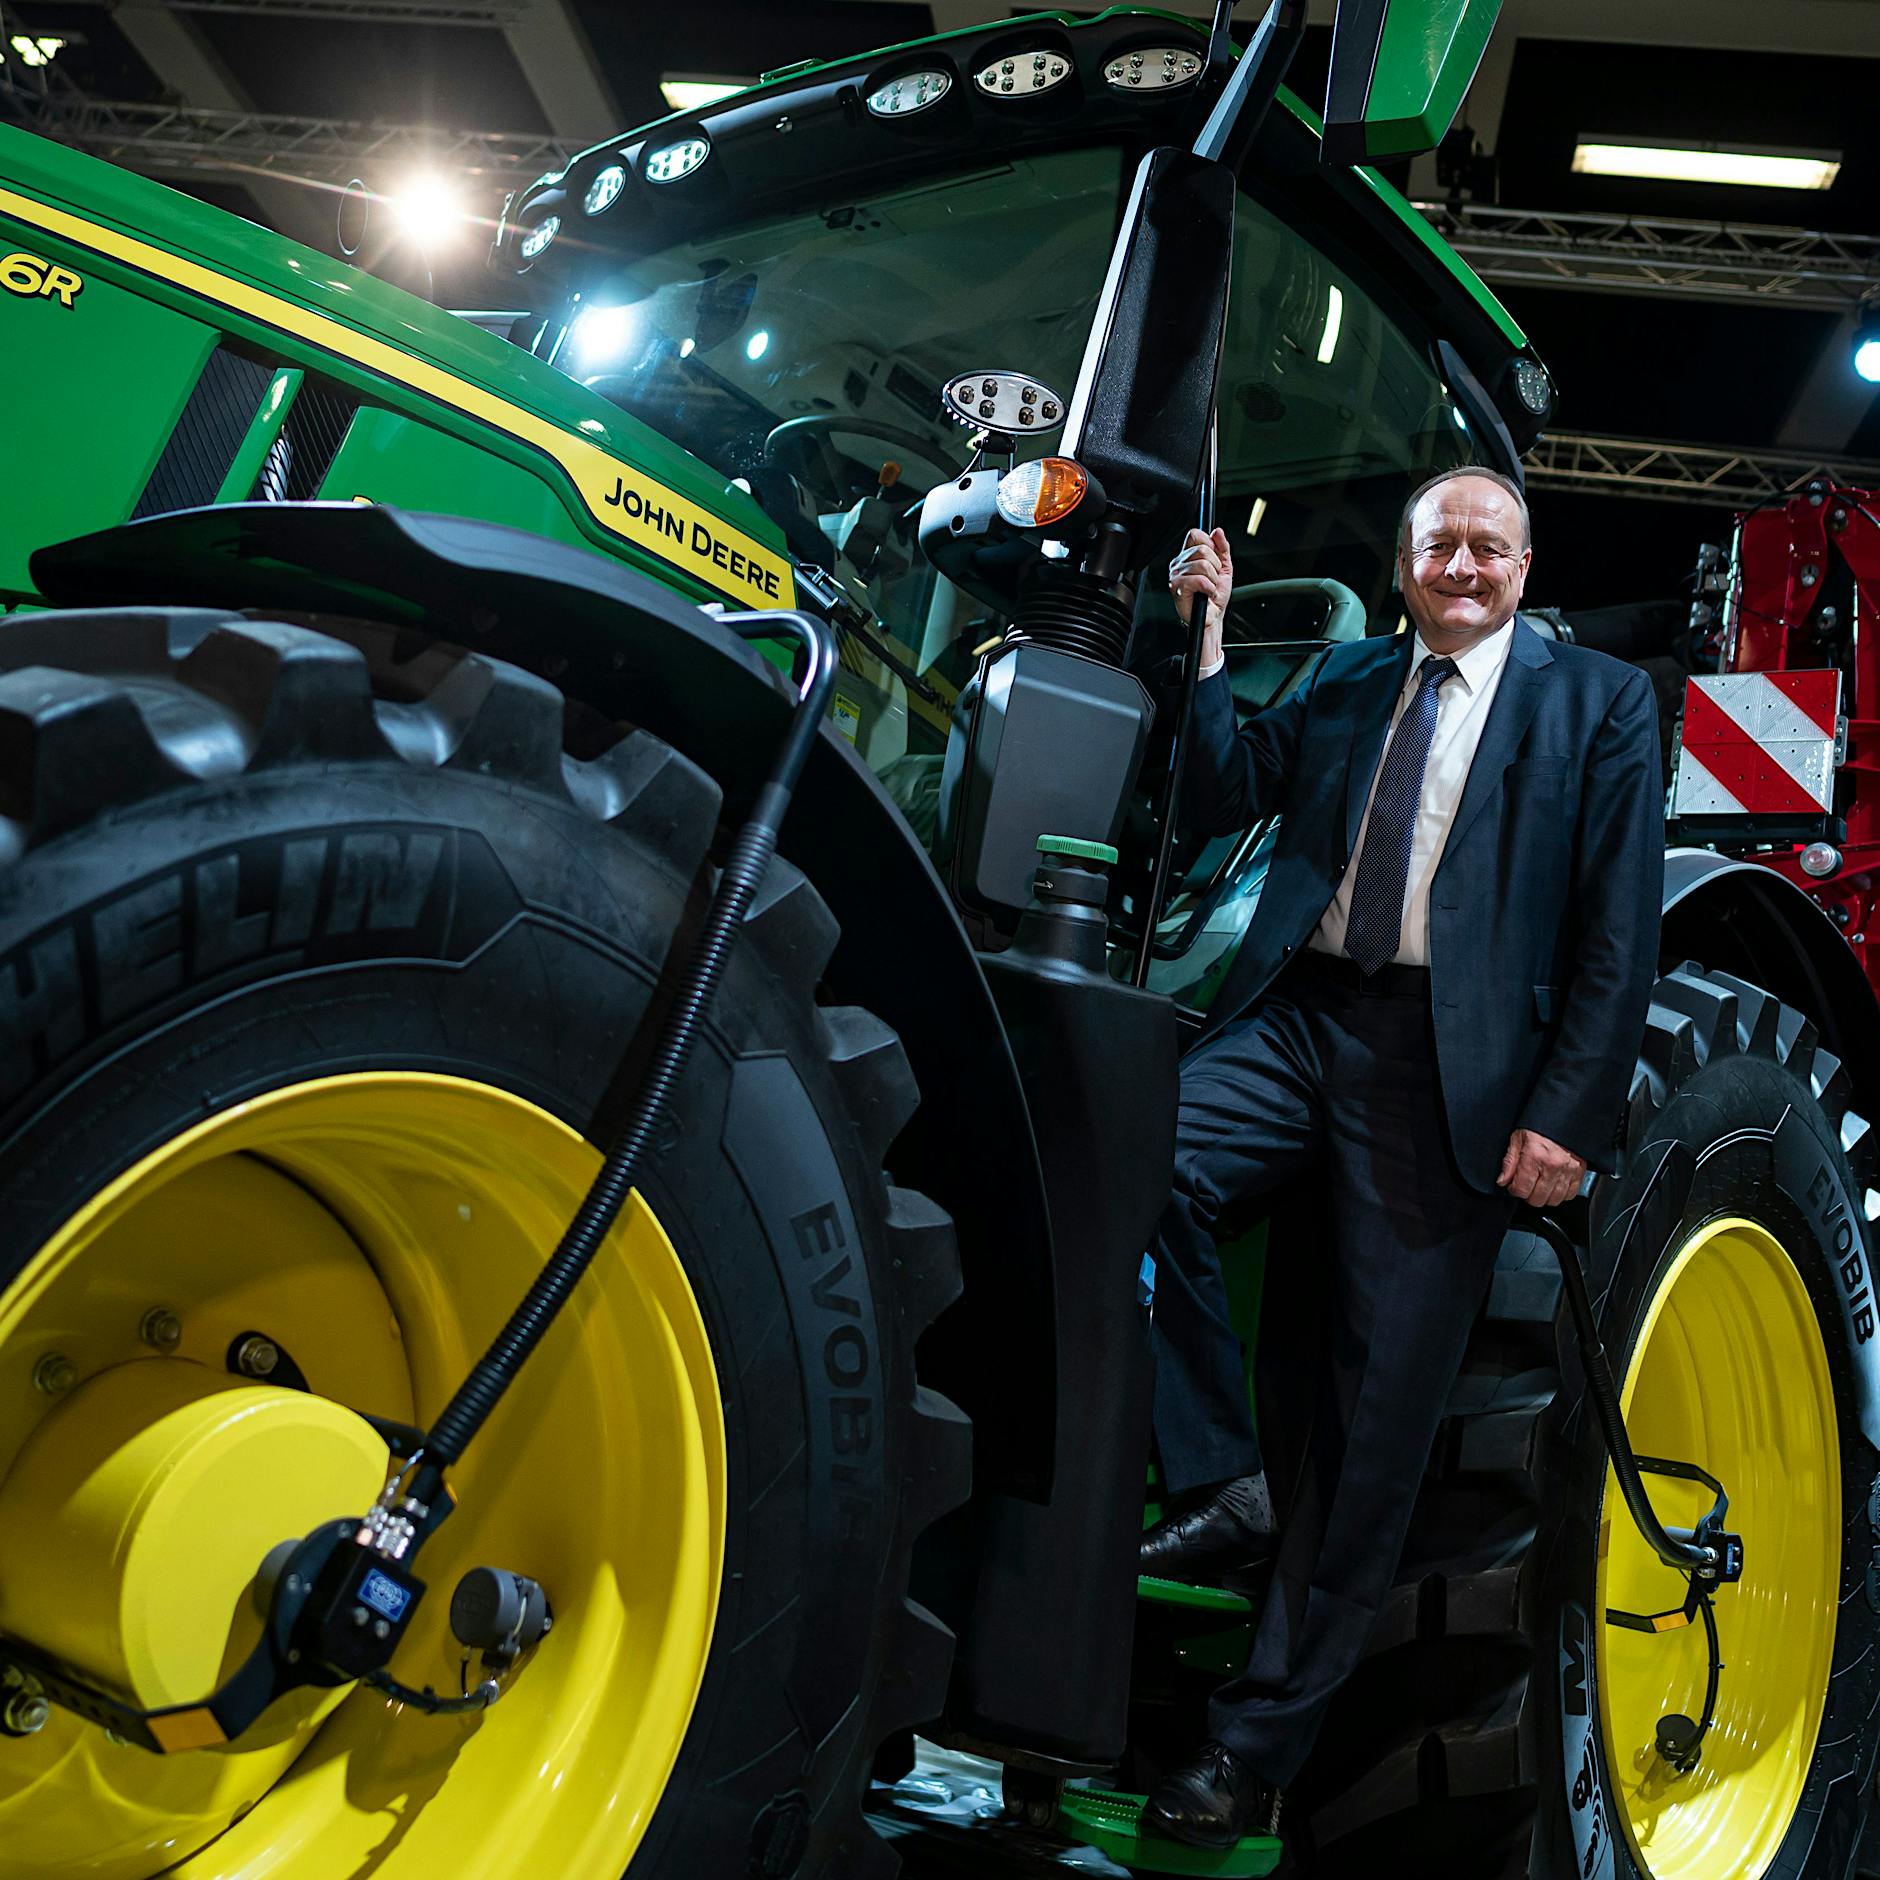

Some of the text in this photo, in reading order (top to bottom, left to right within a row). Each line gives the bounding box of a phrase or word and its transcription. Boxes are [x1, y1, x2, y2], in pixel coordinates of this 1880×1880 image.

[0, 251, 83, 311] 6R
[604, 477, 780, 600] JOHN DEERE
[1806, 1163, 1875, 1345] EVOBIB
